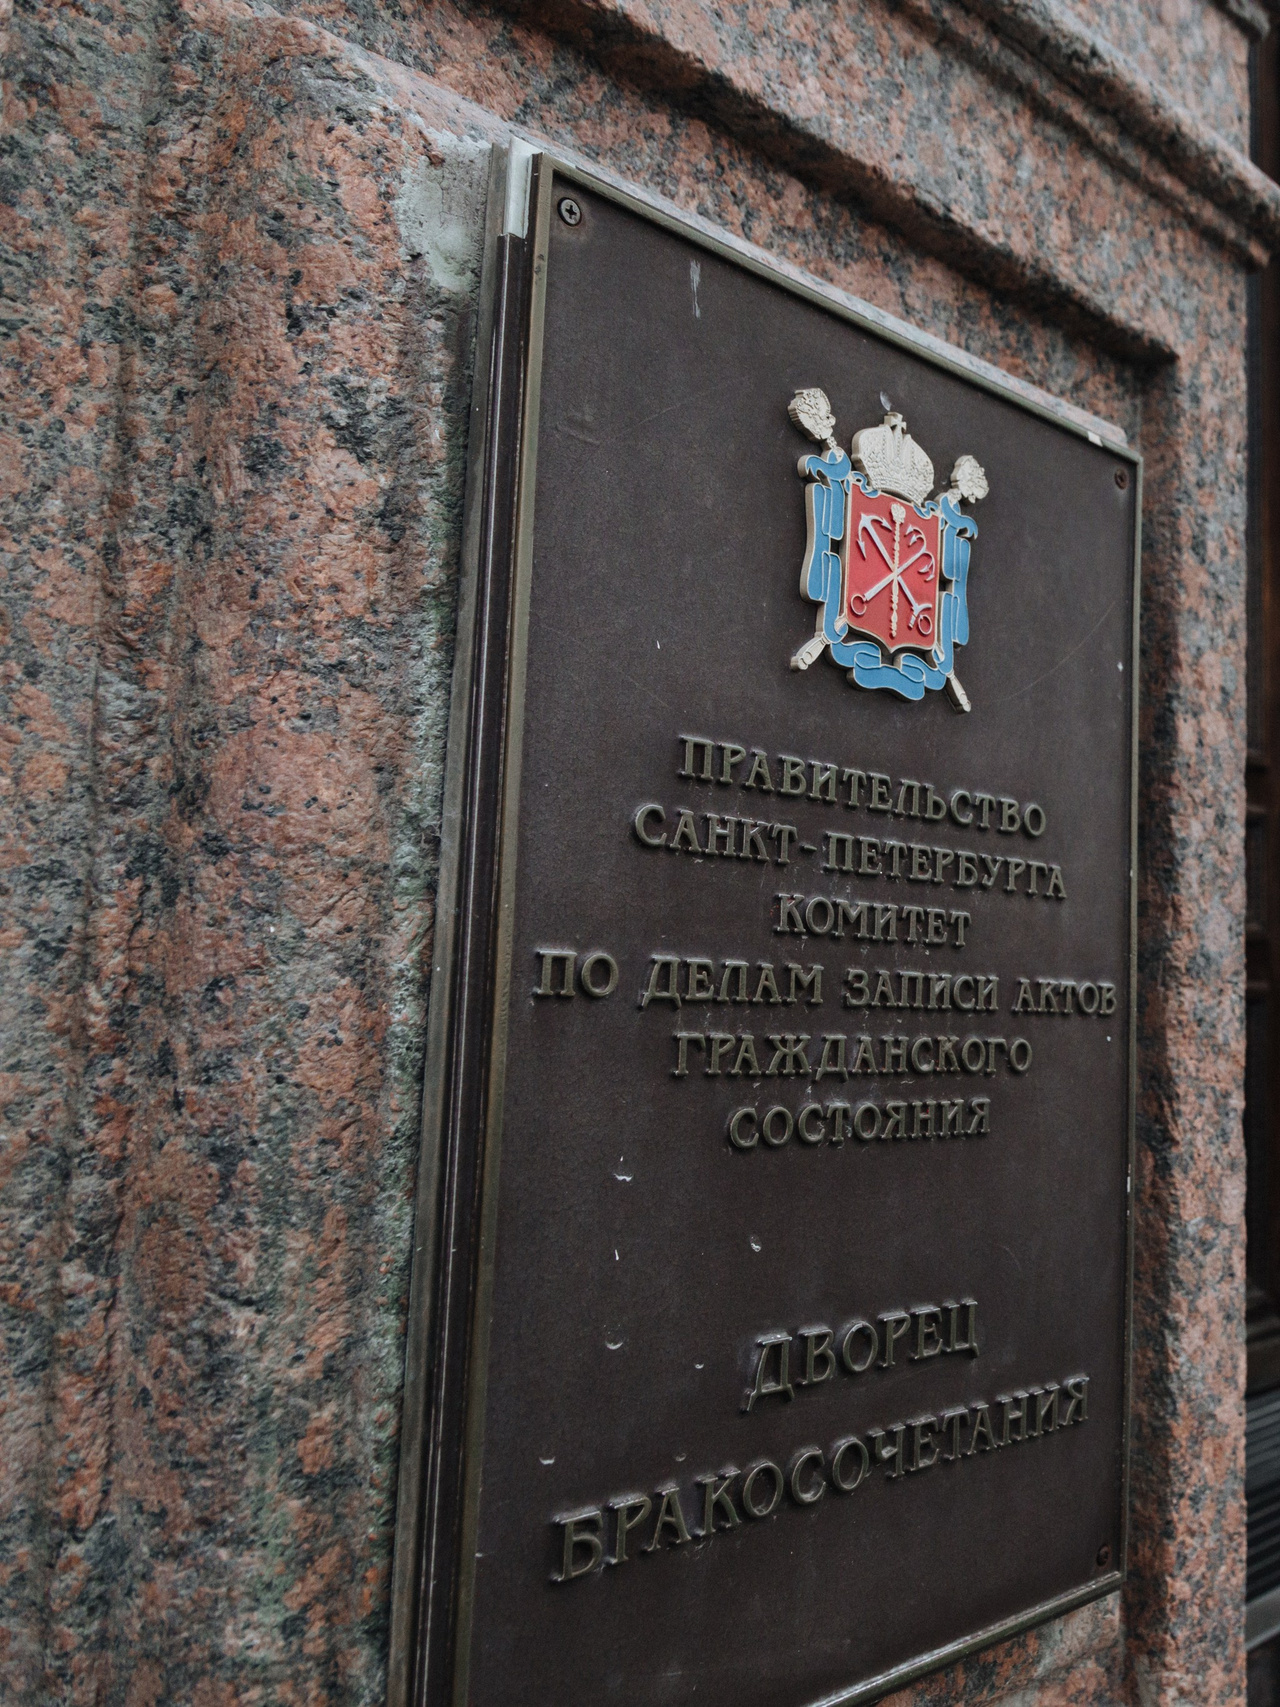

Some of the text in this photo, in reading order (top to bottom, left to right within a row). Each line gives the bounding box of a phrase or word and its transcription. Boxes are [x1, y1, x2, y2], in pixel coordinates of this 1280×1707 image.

[678, 734, 1047, 839] ПРАВИТЕЛЬСТВО
[632, 803, 1067, 900] САНКТ-ПЕТЕРБУРГА
[774, 893, 971, 948] КОМИТЕТ
[534, 949, 1117, 1016] ПО ДЕЛАМ ЗАПИСИ АКТОВ
[671, 1033, 1033, 1083] ГРАЖДАНСКОГО
[729, 1097, 990, 1149] СОСТОЯНИЯ
[740, 1299, 979, 1413] ДВОРЕЦ
[549, 1373, 1090, 1584] БРАКОСОЧЕТАНИЯ
